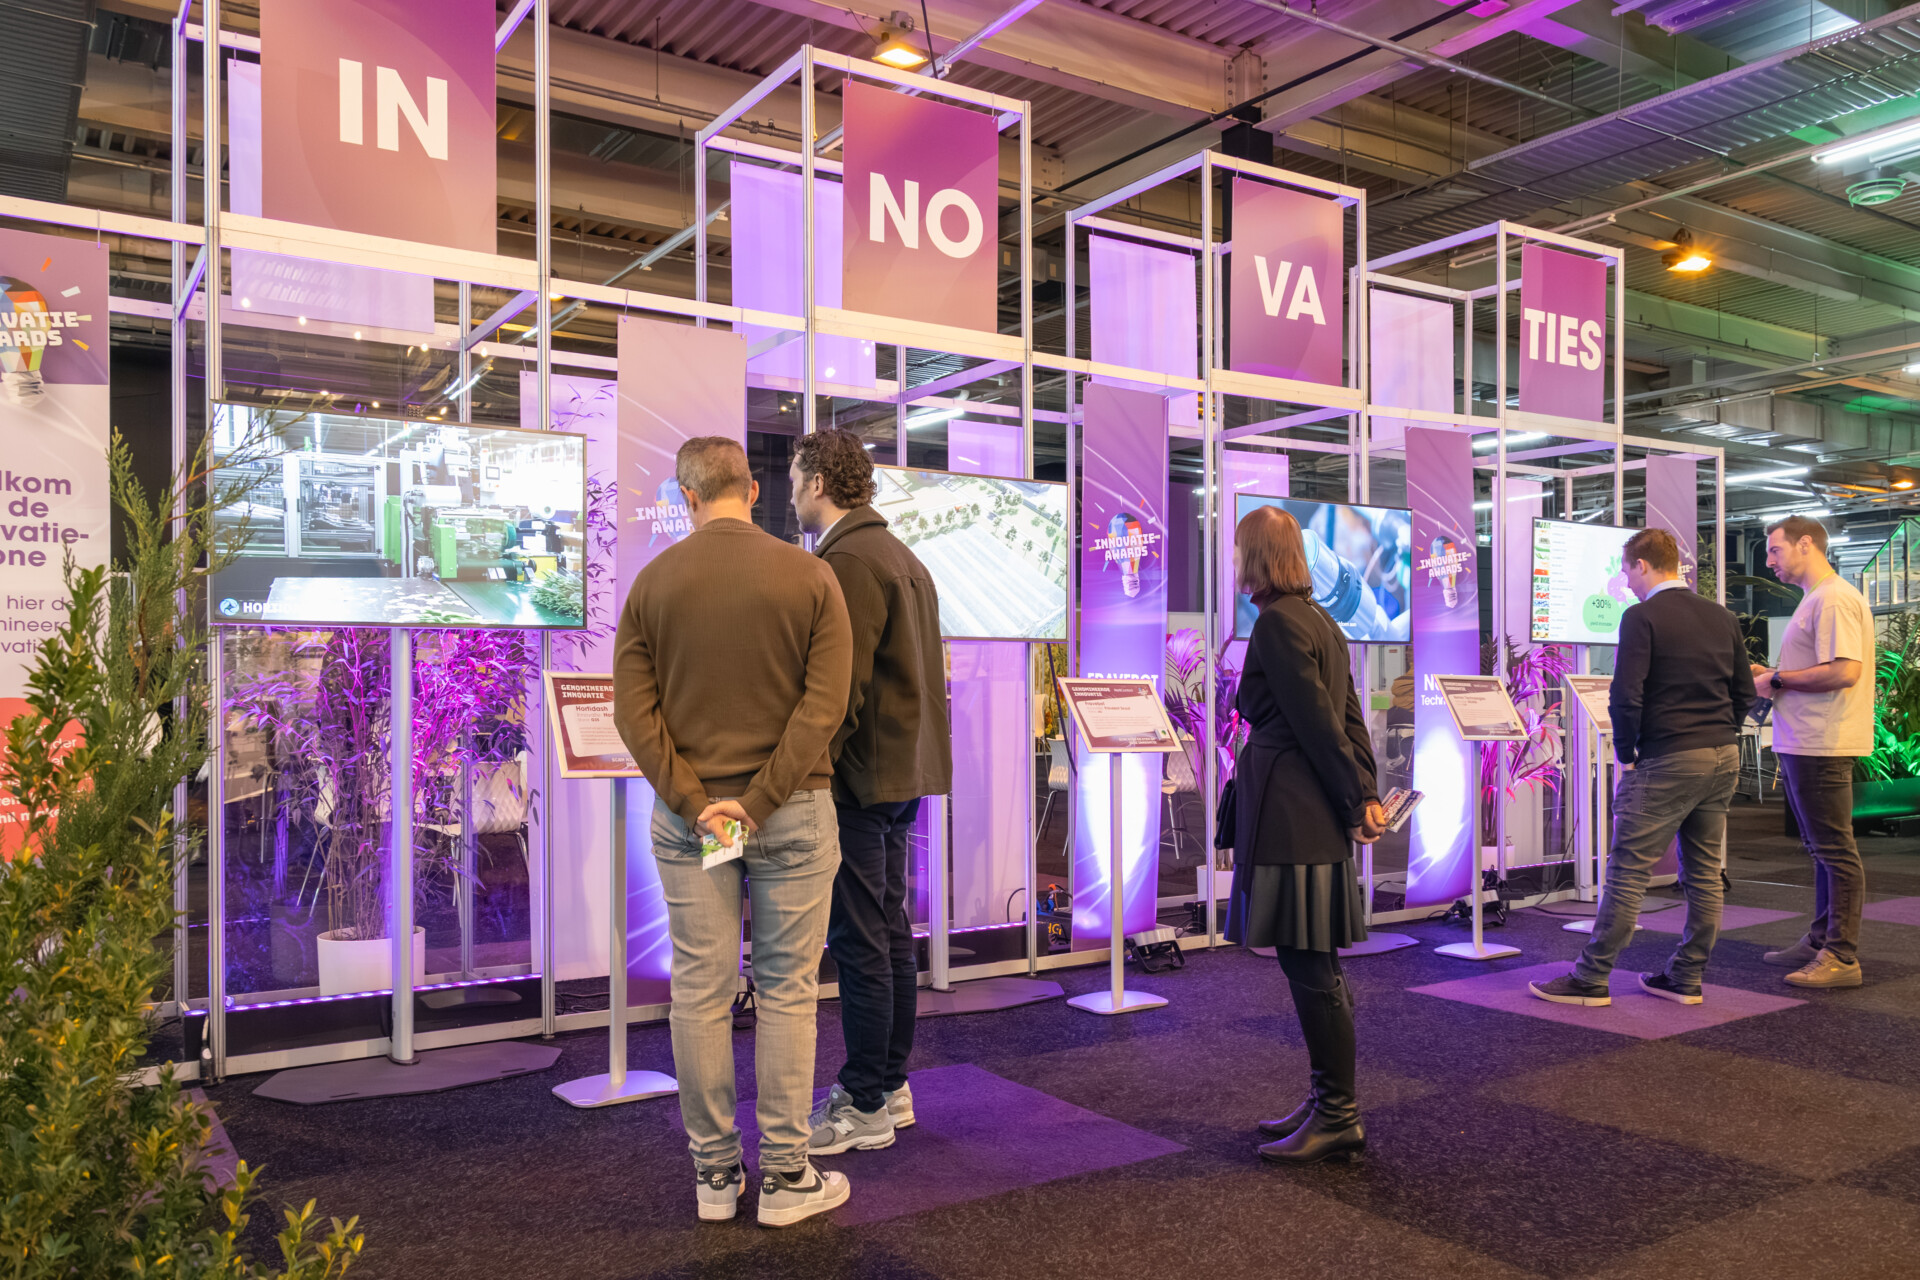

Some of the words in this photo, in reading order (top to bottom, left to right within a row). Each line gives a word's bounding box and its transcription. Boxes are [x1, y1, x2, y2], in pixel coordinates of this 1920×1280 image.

[339, 57, 448, 161] IN
[869, 171, 984, 259] NO
[1254, 254, 1326, 325] VA
[0, 312, 79, 328] VATIE
[0, 330, 63, 346] ARDS
[1524, 307, 1602, 371] TIES
[8, 496, 49, 518] de
[0, 522, 89, 544] vatie-
[1094, 533, 1155, 550] INNOVATIE
[1105, 546, 1148, 561] AWARDS
[1420, 552, 1468, 569] INNOVATIE
[1428, 564, 1463, 578] AWARDS
[7, 595, 45, 610] hier
[1592, 599, 1611, 609] +30%
